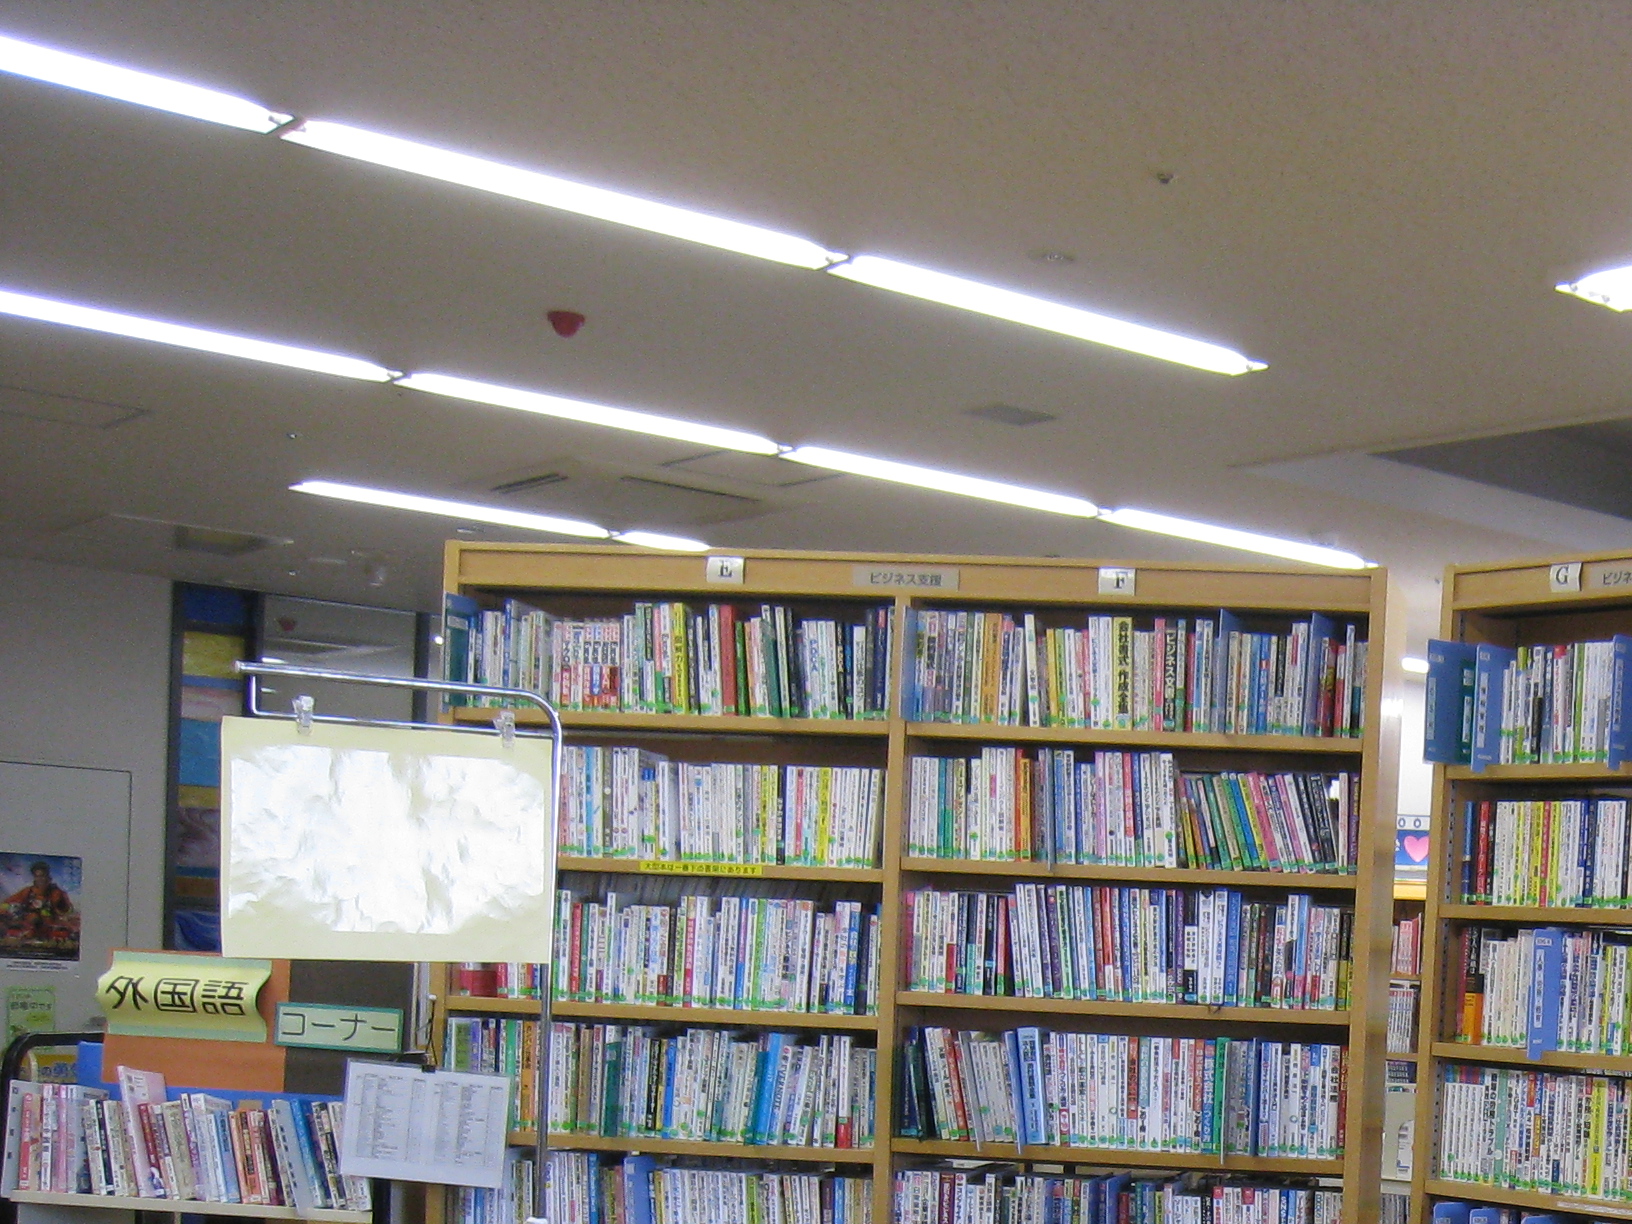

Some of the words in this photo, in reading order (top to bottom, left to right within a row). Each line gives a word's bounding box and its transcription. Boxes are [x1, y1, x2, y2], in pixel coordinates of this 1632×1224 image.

[717, 558, 733, 578] E
[1555, 565, 1569, 585] G
[870, 571, 942, 586] ビジネス支援
[1112, 571, 1127, 591] F
[104, 975, 249, 1017] 外国語
[281, 1012, 397, 1042] コーナー
